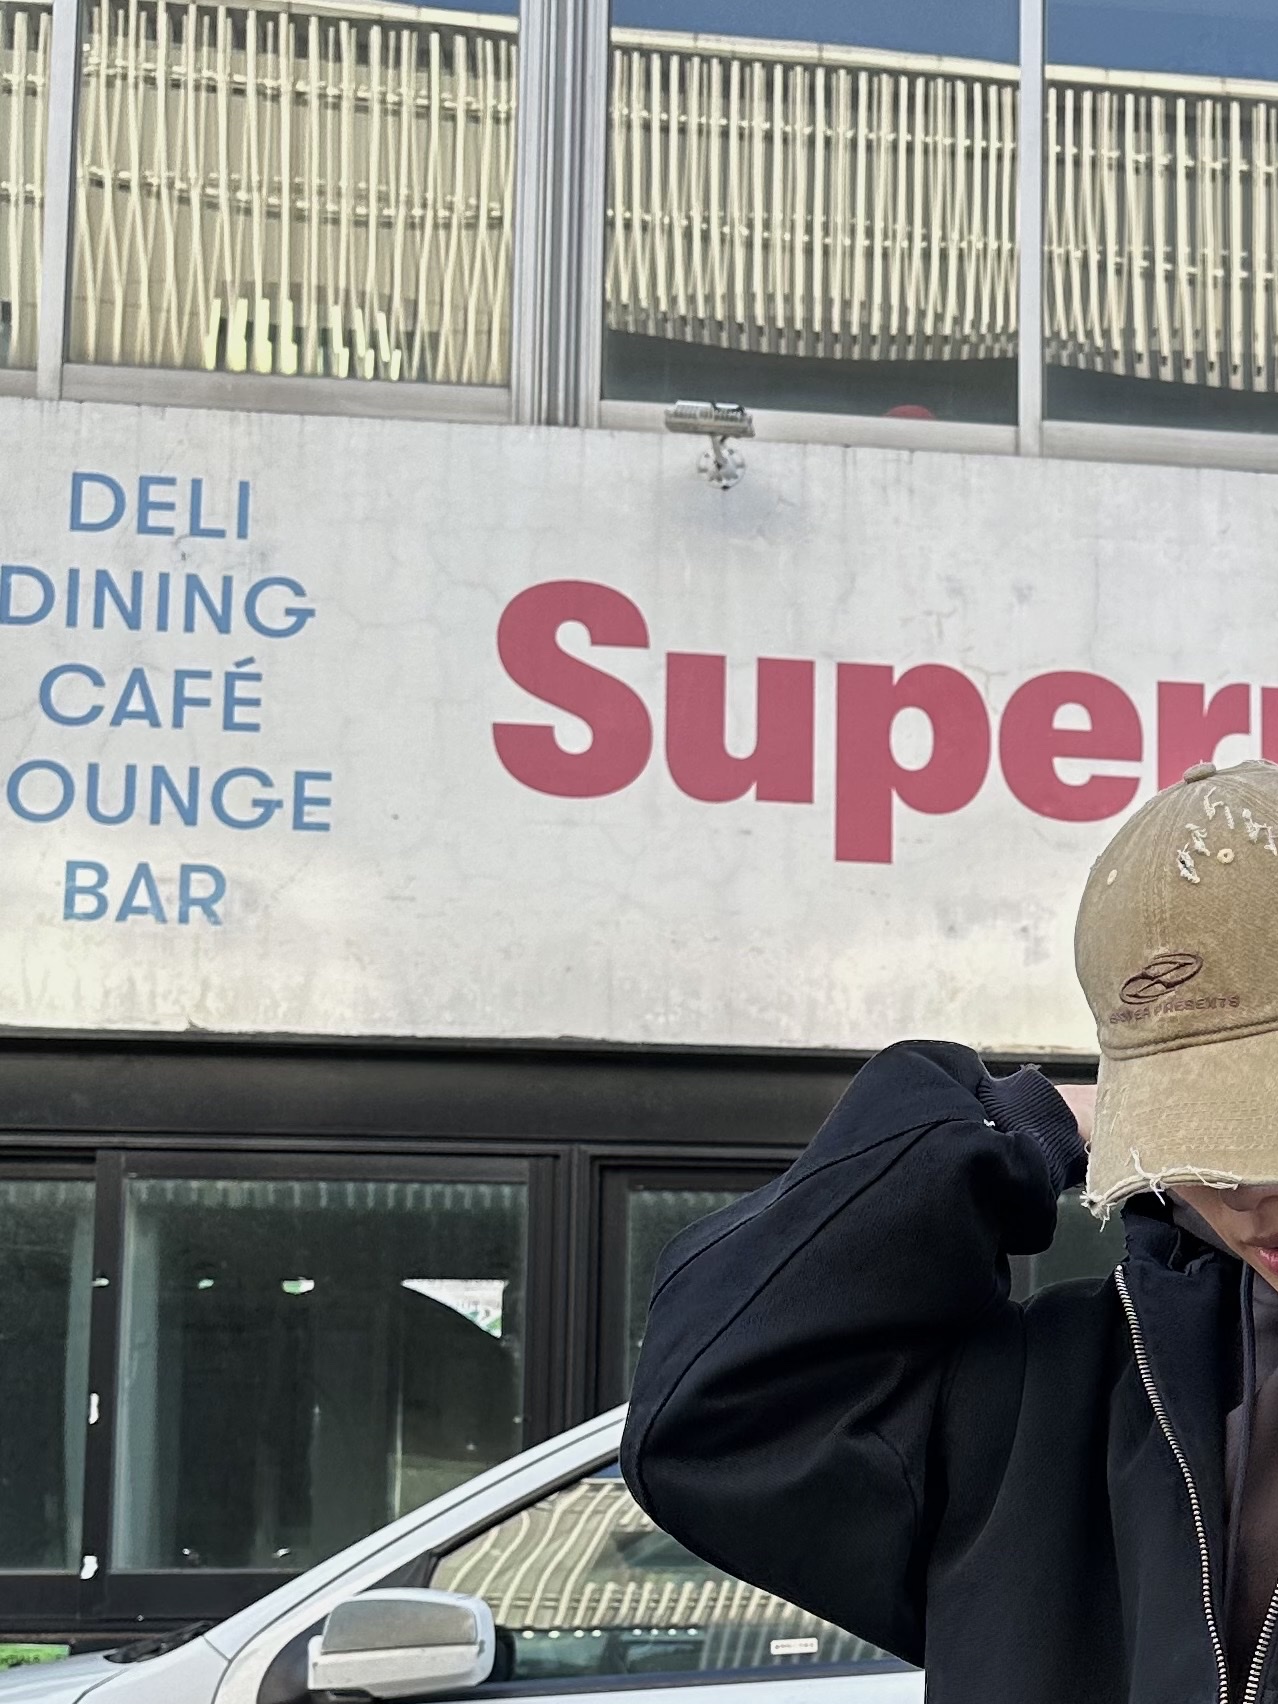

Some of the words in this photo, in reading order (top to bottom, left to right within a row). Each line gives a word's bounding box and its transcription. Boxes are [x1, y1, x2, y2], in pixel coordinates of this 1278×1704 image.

[69, 471, 251, 540] DELI
[0, 565, 316, 639] DINING
[39, 656, 263, 733] CAFÉ
[6, 759, 333, 832] OUNGE
[62, 860, 227, 925] BAR
